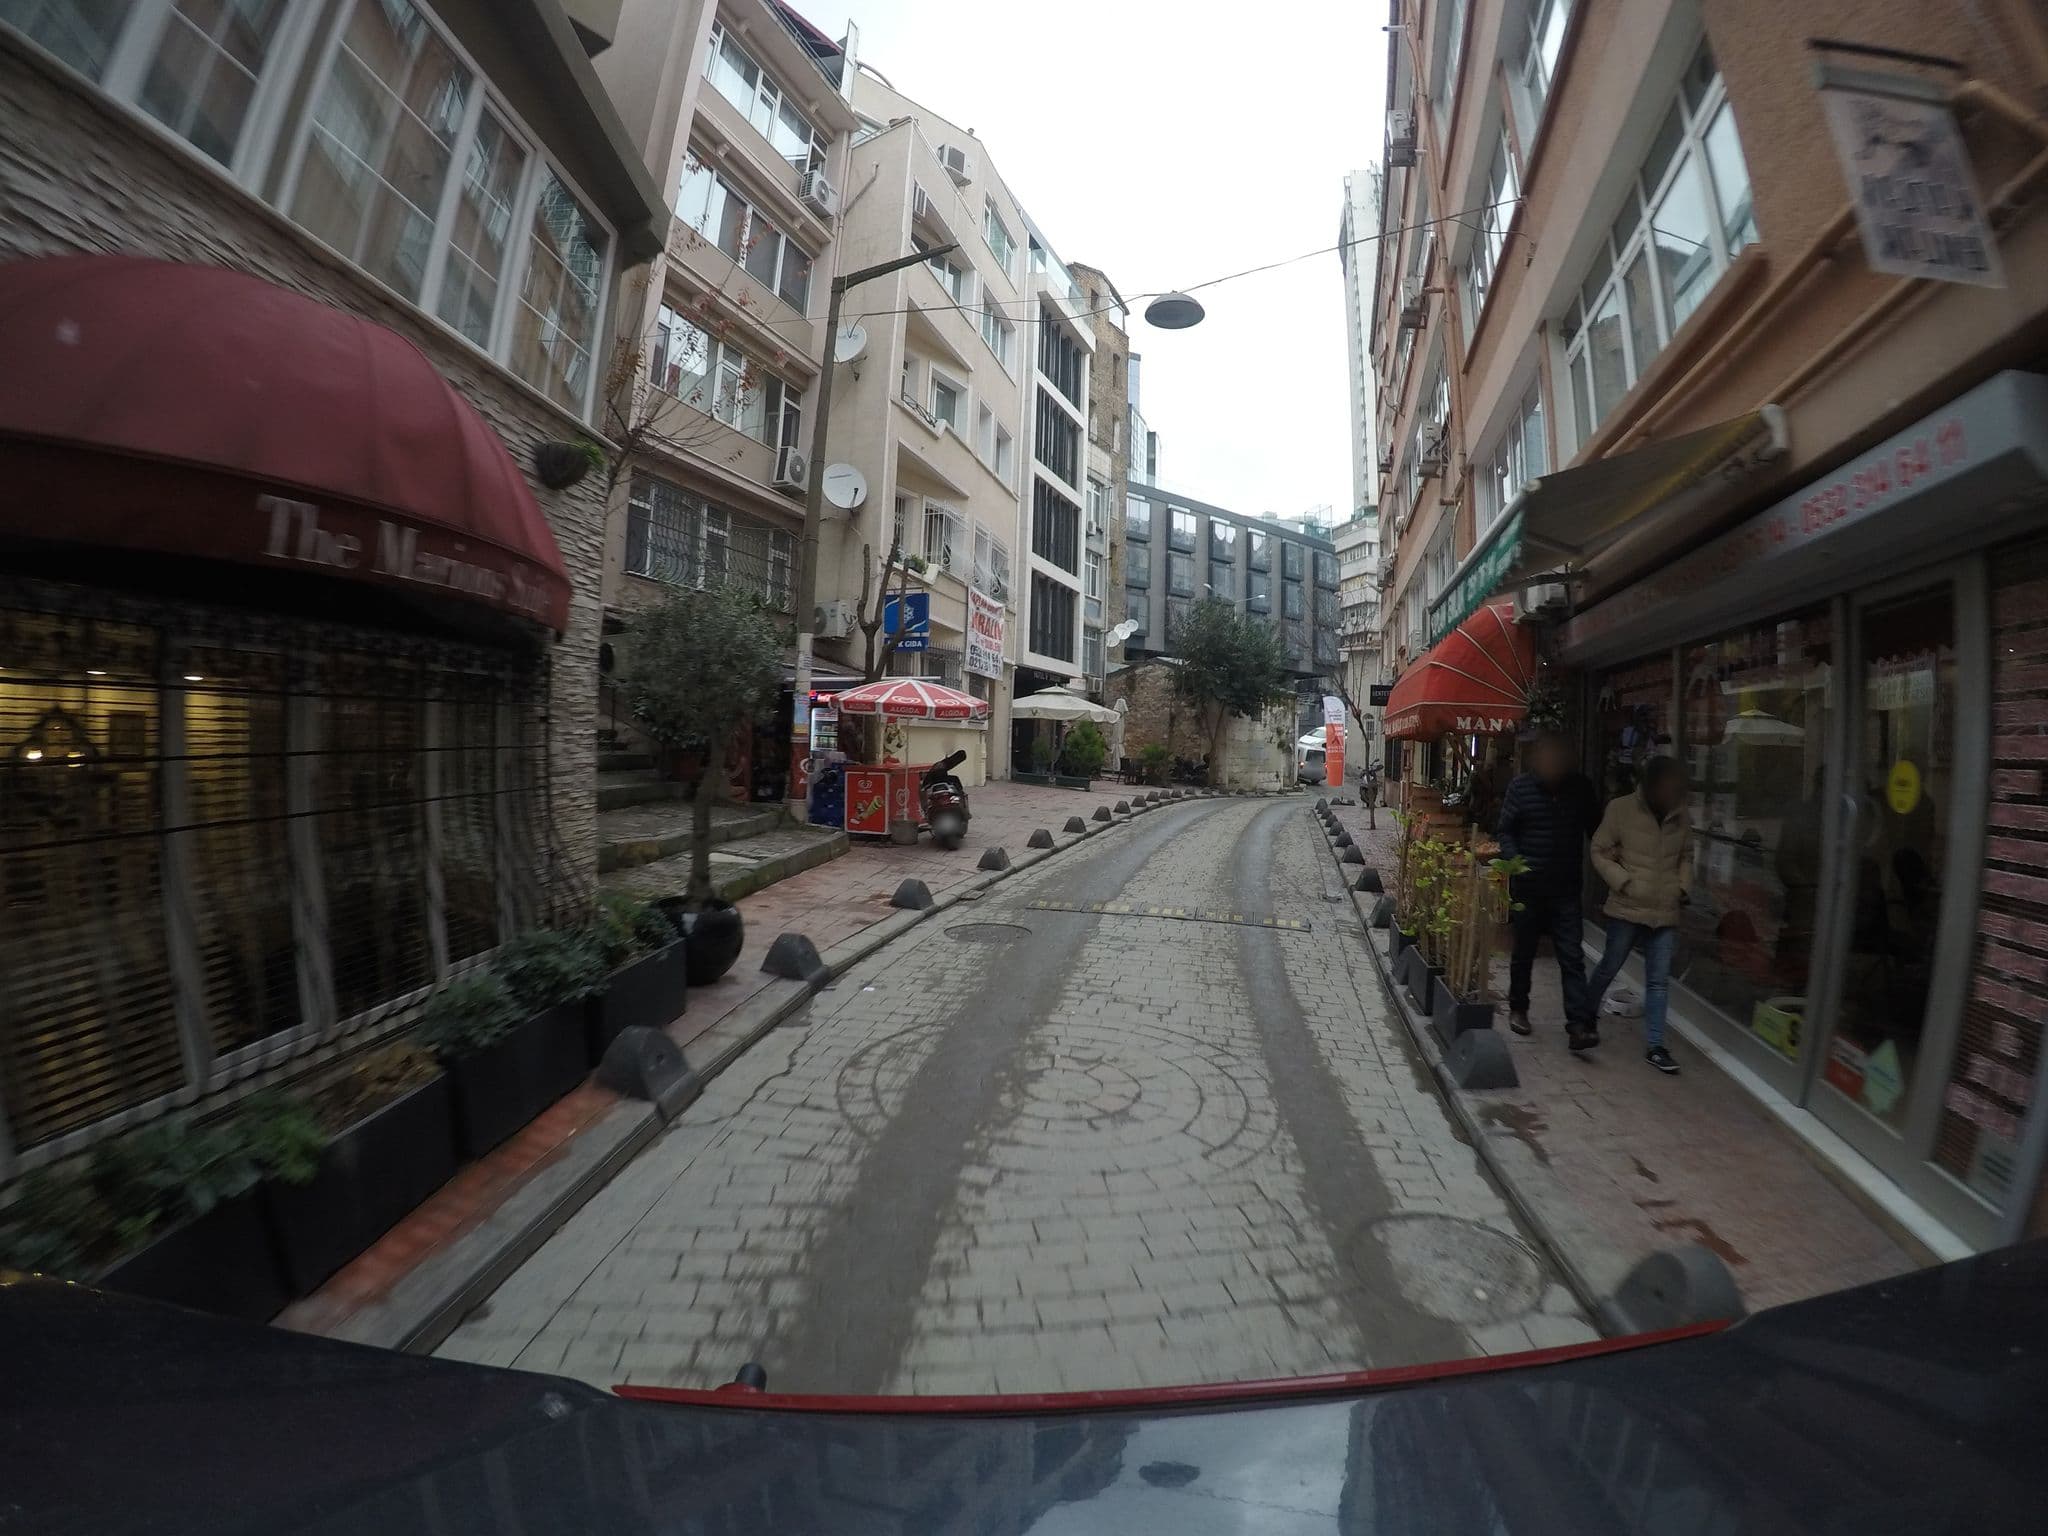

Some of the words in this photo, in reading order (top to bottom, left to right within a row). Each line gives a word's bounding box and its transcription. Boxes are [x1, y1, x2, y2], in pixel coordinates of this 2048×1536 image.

[256, 493, 362, 568] The
[904, 640, 922, 648] GIDA
[890, 705, 921, 714] ALGIDA
[939, 708, 965, 717] ALGIDA
